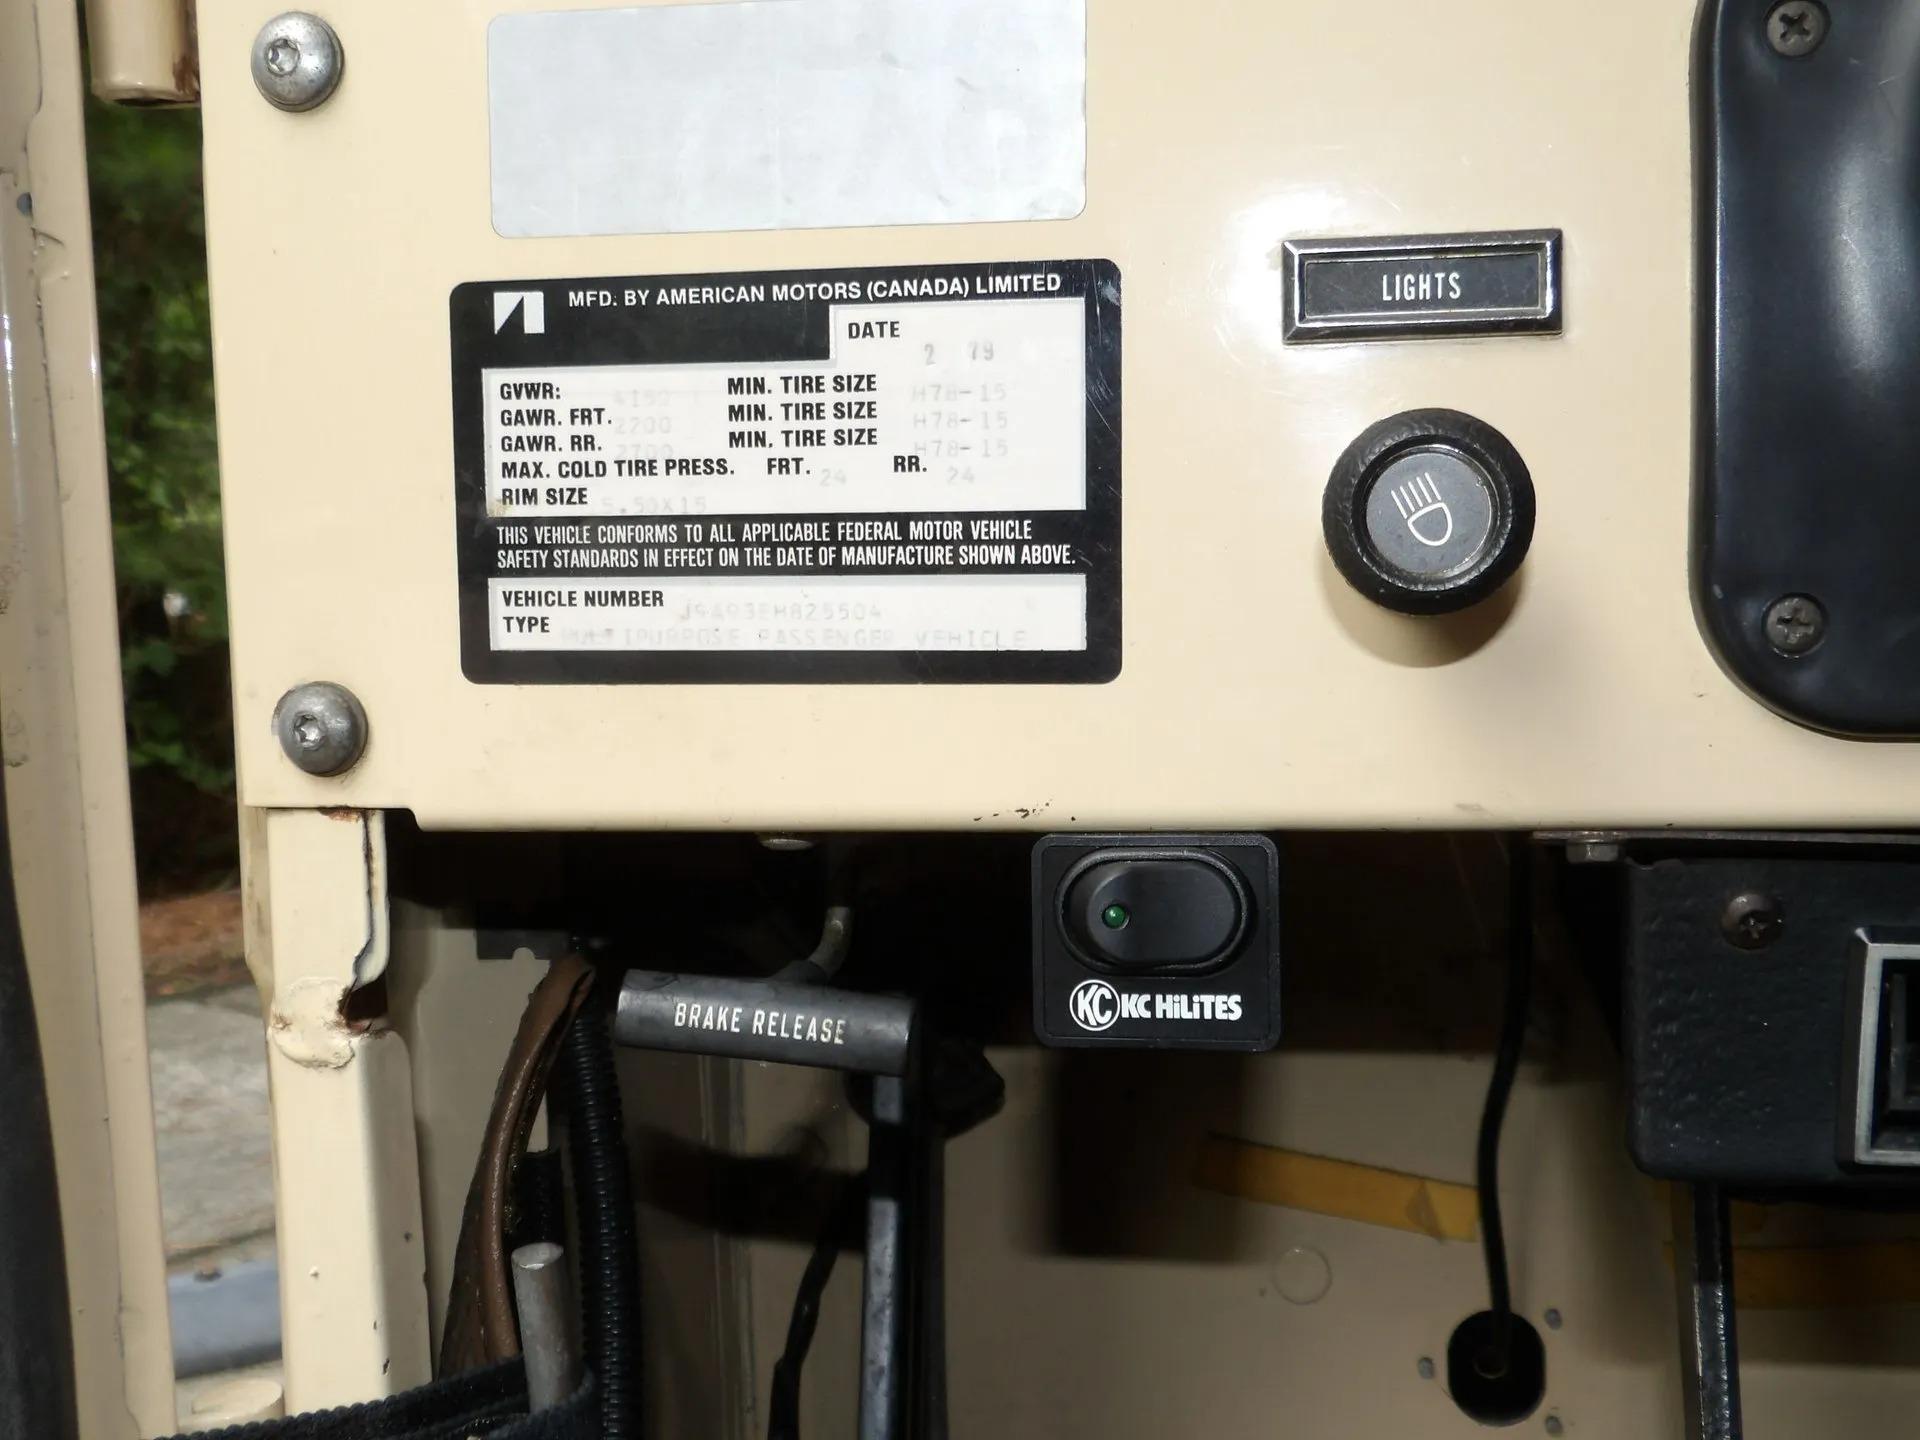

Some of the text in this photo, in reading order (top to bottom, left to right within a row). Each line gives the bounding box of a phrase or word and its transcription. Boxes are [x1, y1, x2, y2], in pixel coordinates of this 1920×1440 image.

[624, 289, 650, 306] BY
[656, 285, 765, 305] AMERICAN
[772, 281, 862, 302] MOTORS
[866, 277, 970, 302] (CANADA)
[975, 272, 1061, 294] LIMITED
[1382, 271, 1461, 301] LIGHTS
[847, 320, 900, 340] DATE
[923, 344, 935, 364] 2
[499, 382, 561, 401] GVWR:
[727, 376, 772, 396] MIN.
[779, 375, 826, 395] TIRE
[832, 374, 877, 393] SIZE
[500, 408, 562, 427] GAWR.
[569, 407, 612, 426] FRT.
[728, 403, 773, 423] MIN.
[780, 402, 826, 421] TIRE
[832, 400, 878, 420] SIZE
[500, 435, 563, 453] GAWR.
[570, 434, 602, 452] RR.
[780, 429, 826, 448] TIRE
[833, 427, 878, 447] SIZE
[501, 457, 735, 479] MAX. COLD TIRE PRESS.
[767, 457, 811, 475] FRT.
[893, 454, 928, 473] RR.
[501, 487, 538, 506] RIM
[545, 487, 588, 506] SIZE
[496, 519, 1032, 545] THIS VEHICLE CONFORMS TO ALL APPLICABLE FEDERAL MOTOR VEHICLE
[497, 544, 1076, 569] SAFETY STANDARDS IN EFFECT ON THE DATE OF MANUFACTURE SHOWN ABOVE.
[501, 590, 578, 607] VEHICLE
[584, 590, 664, 608] NUMBER
[502, 616, 550, 633] TYPE
[915, 629, 1028, 647] VEHICLE
[1077, 985, 1113, 1026] KC
[1121, 993, 1152, 1019] KC
[673, 1001, 846, 1045] BRAKE RELEASE
